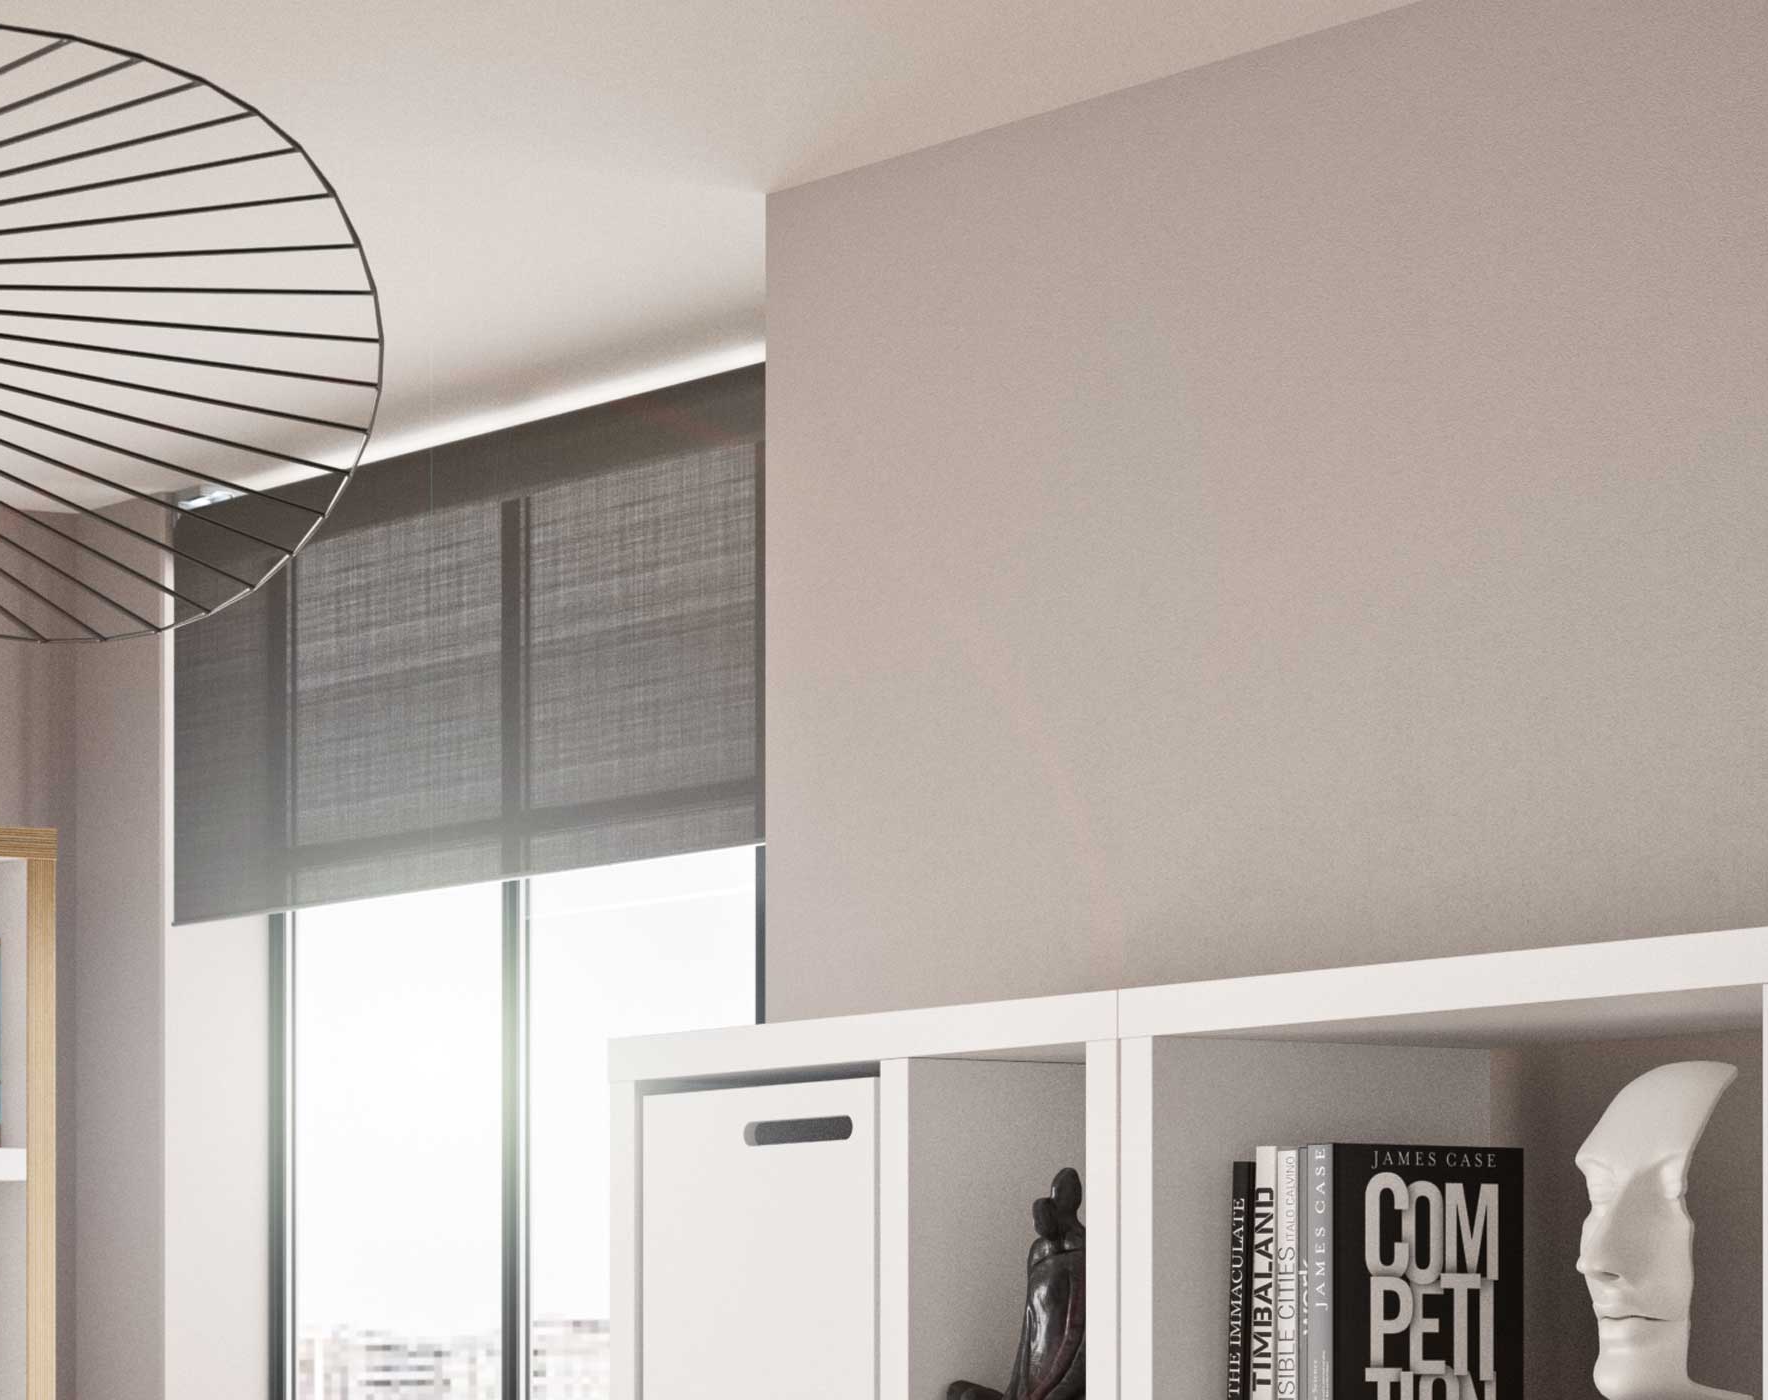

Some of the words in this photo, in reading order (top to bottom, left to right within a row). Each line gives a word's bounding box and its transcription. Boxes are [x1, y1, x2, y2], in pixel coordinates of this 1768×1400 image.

[1284, 1155, 1296, 1205] CALVINO
[1315, 1148, 1327, 1214] CASE
[1371, 1150, 1437, 1168] JAMES
[1446, 1152, 1497, 1168] CASE
[1284, 1208, 1296, 1242] ITALO
[1365, 1171, 1499, 1285] COM
[1229, 1198, 1245, 1355] IMMACULATE
[1252, 1187, 1274, 1391] TIMBALAND
[1278, 1246, 1296, 1321] CITIES
[1315, 1226, 1329, 1311] JAMES
[1369, 1273, 1494, 1381] PETI
[1228, 1359, 1241, 1398] THE
